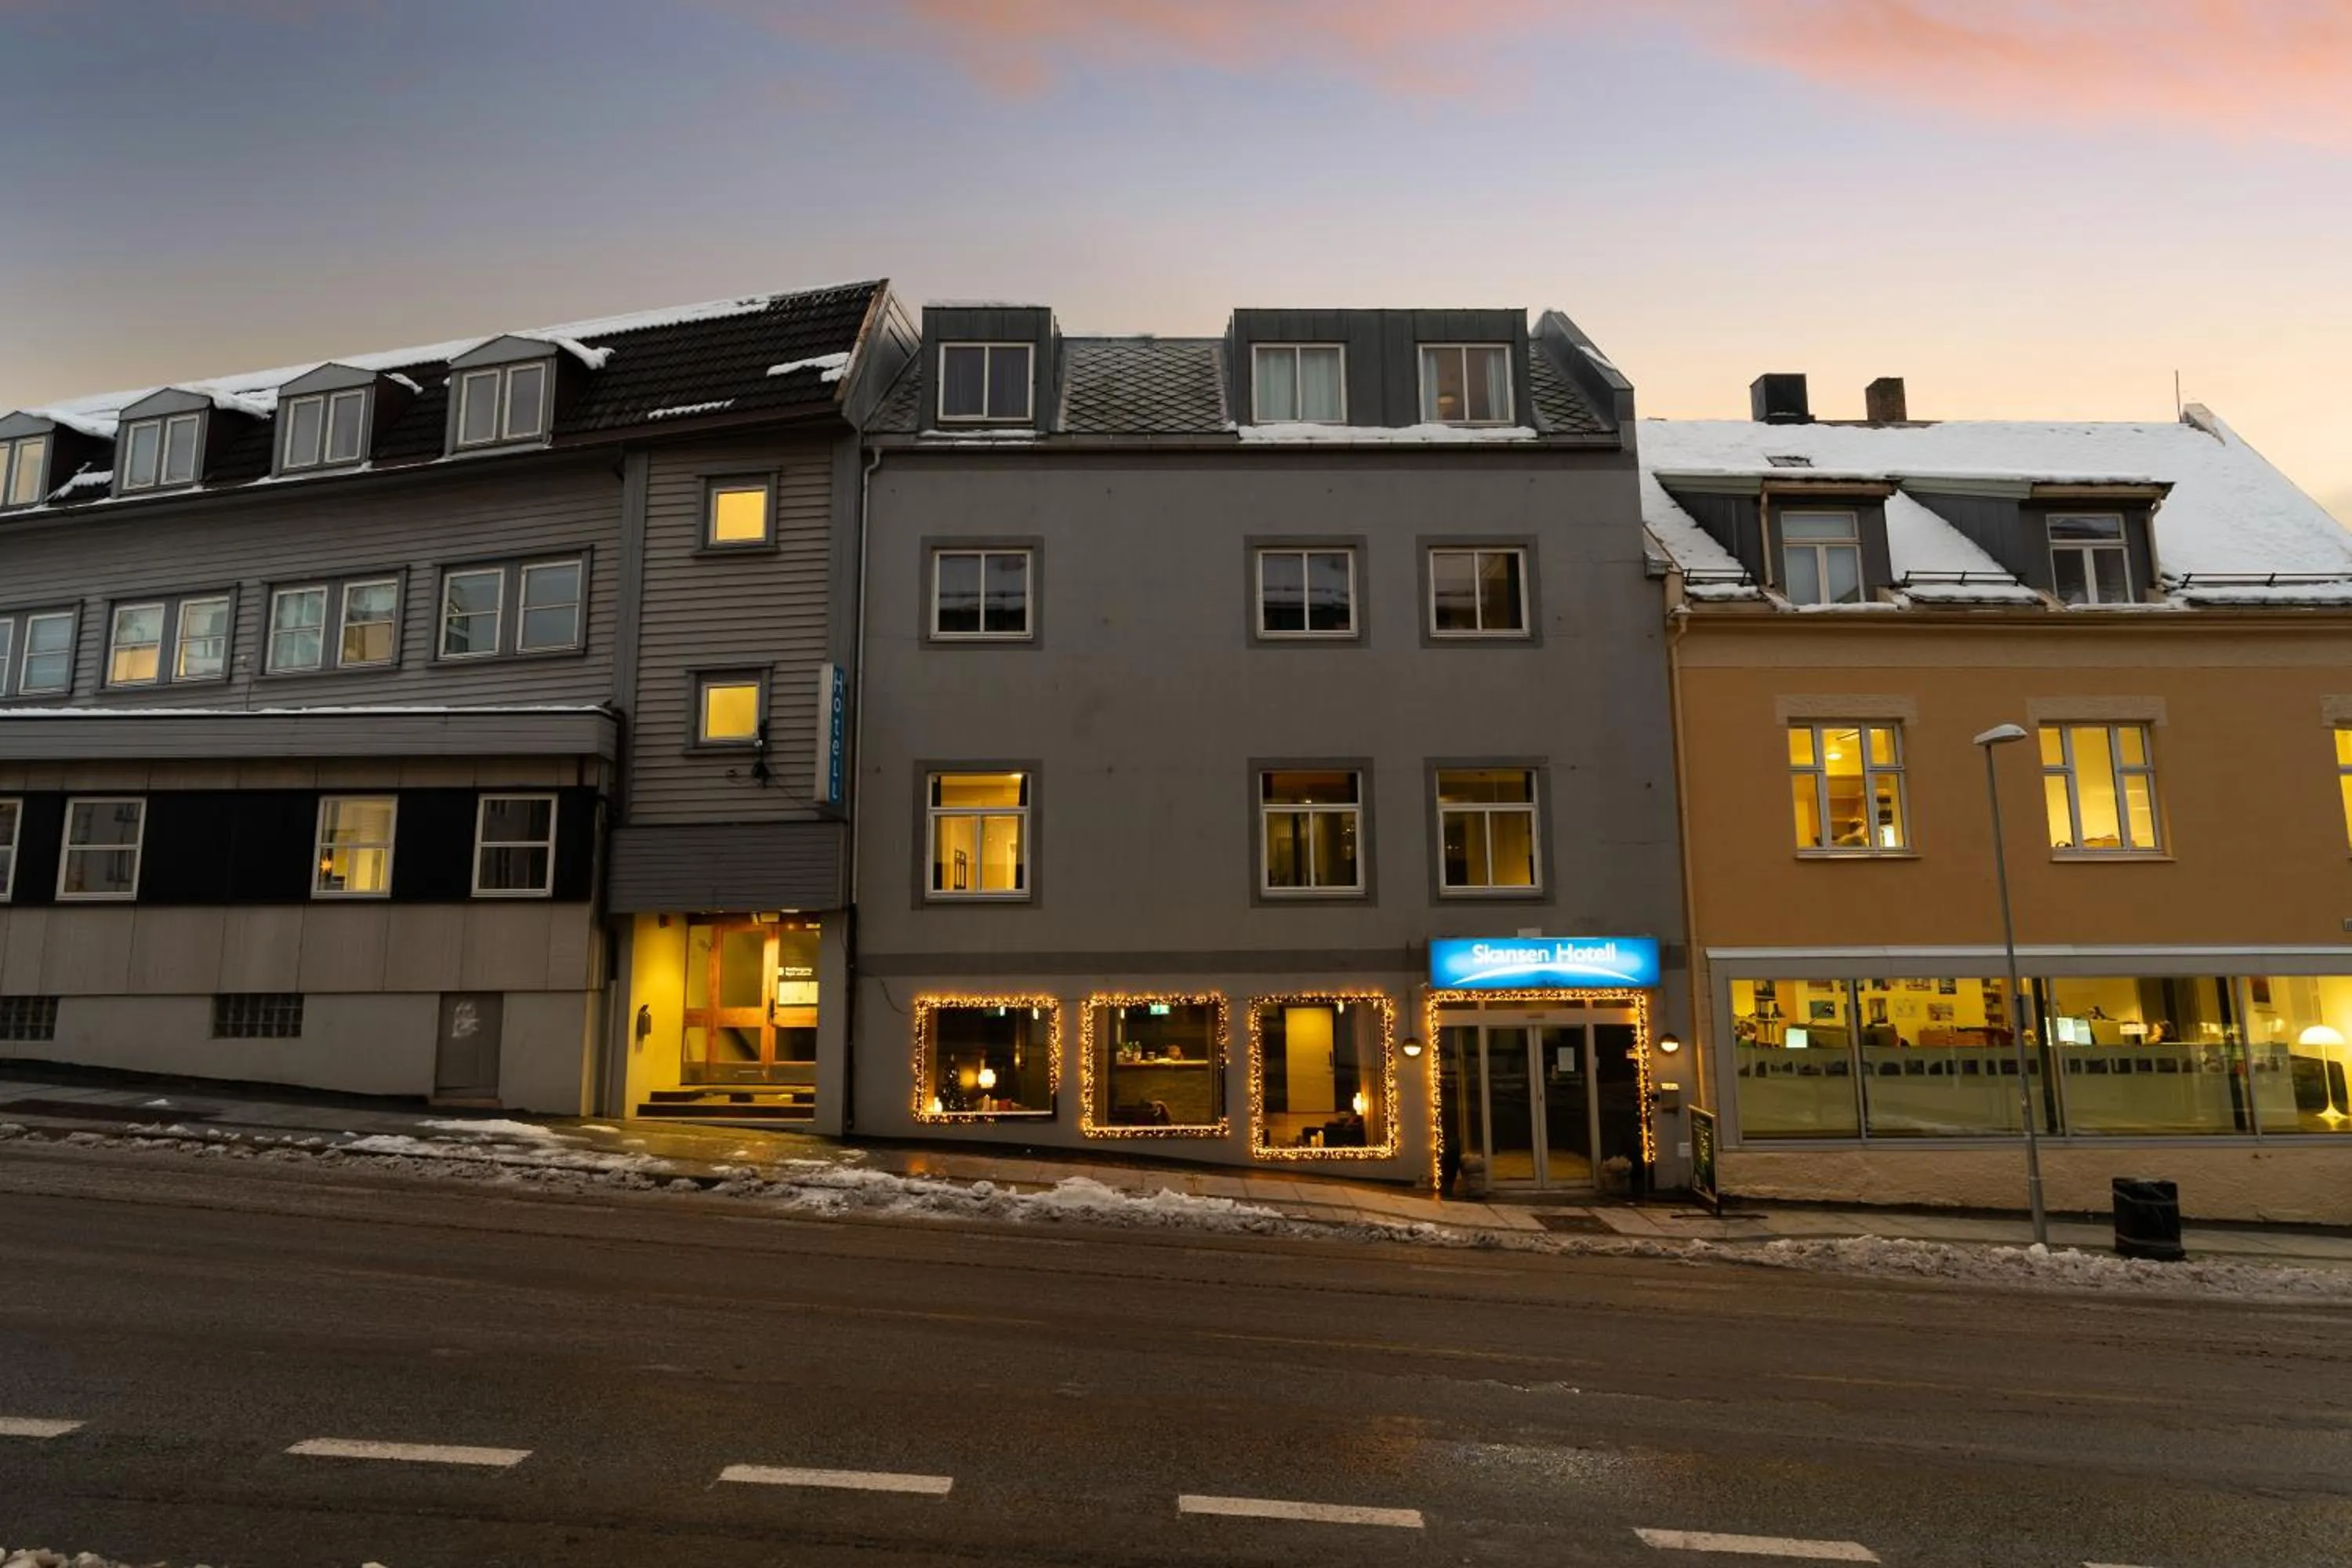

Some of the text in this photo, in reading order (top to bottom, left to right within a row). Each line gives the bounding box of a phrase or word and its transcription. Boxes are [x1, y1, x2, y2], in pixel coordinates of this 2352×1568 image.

[833, 671, 843, 799] Hotell
[1473, 942, 1616, 964] Skansen Hotell
